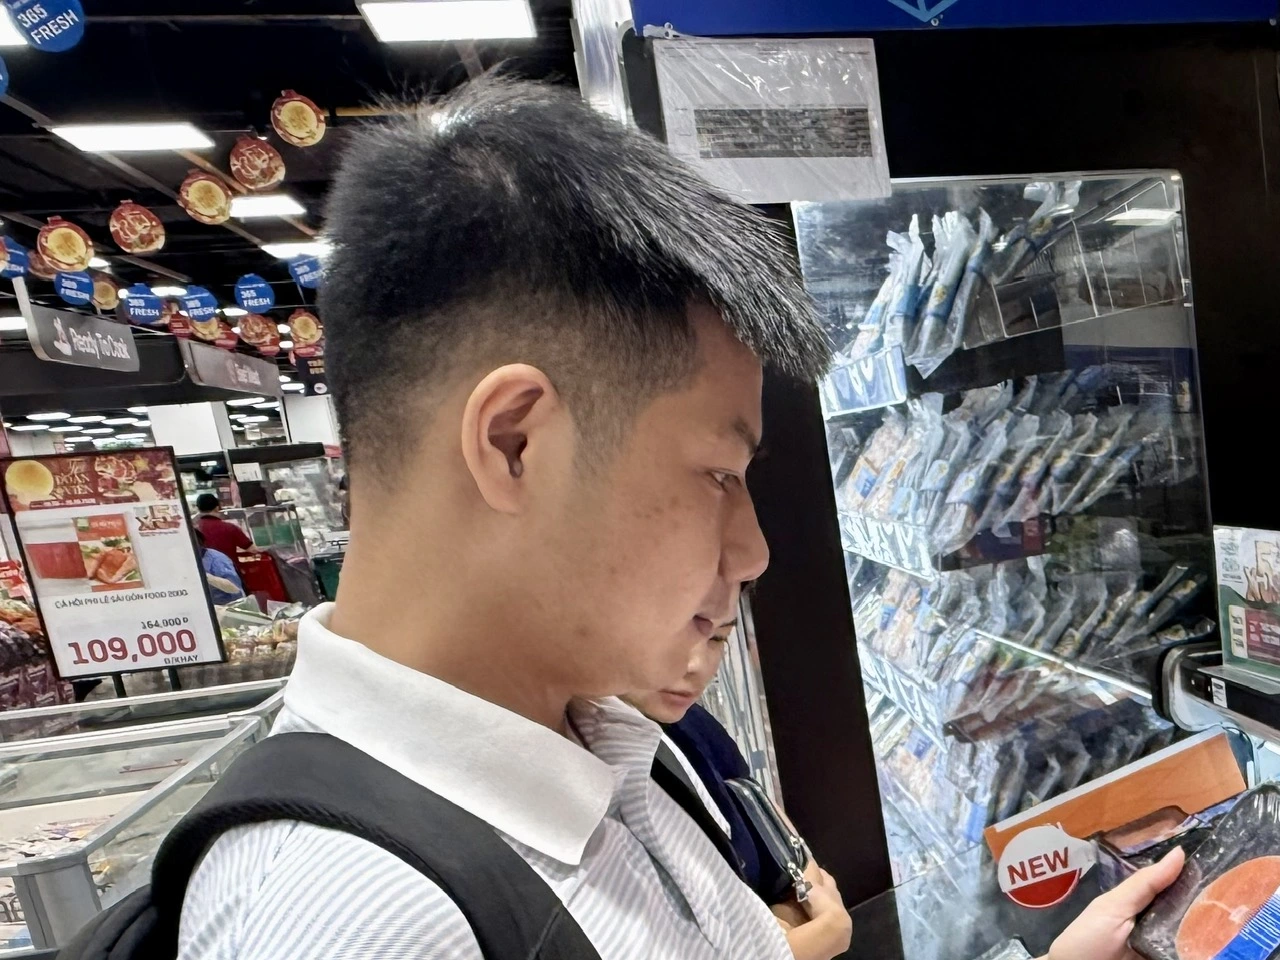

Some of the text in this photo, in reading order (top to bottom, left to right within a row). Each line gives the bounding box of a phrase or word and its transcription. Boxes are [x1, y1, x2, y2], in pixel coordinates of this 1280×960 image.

[17, 4, 48, 28] 365
[30, 9, 80, 45] FRESH
[243, 298, 271, 307] FRESH
[68, 629, 197, 665] 109,000
[1006, 846, 1069, 886] NEW
